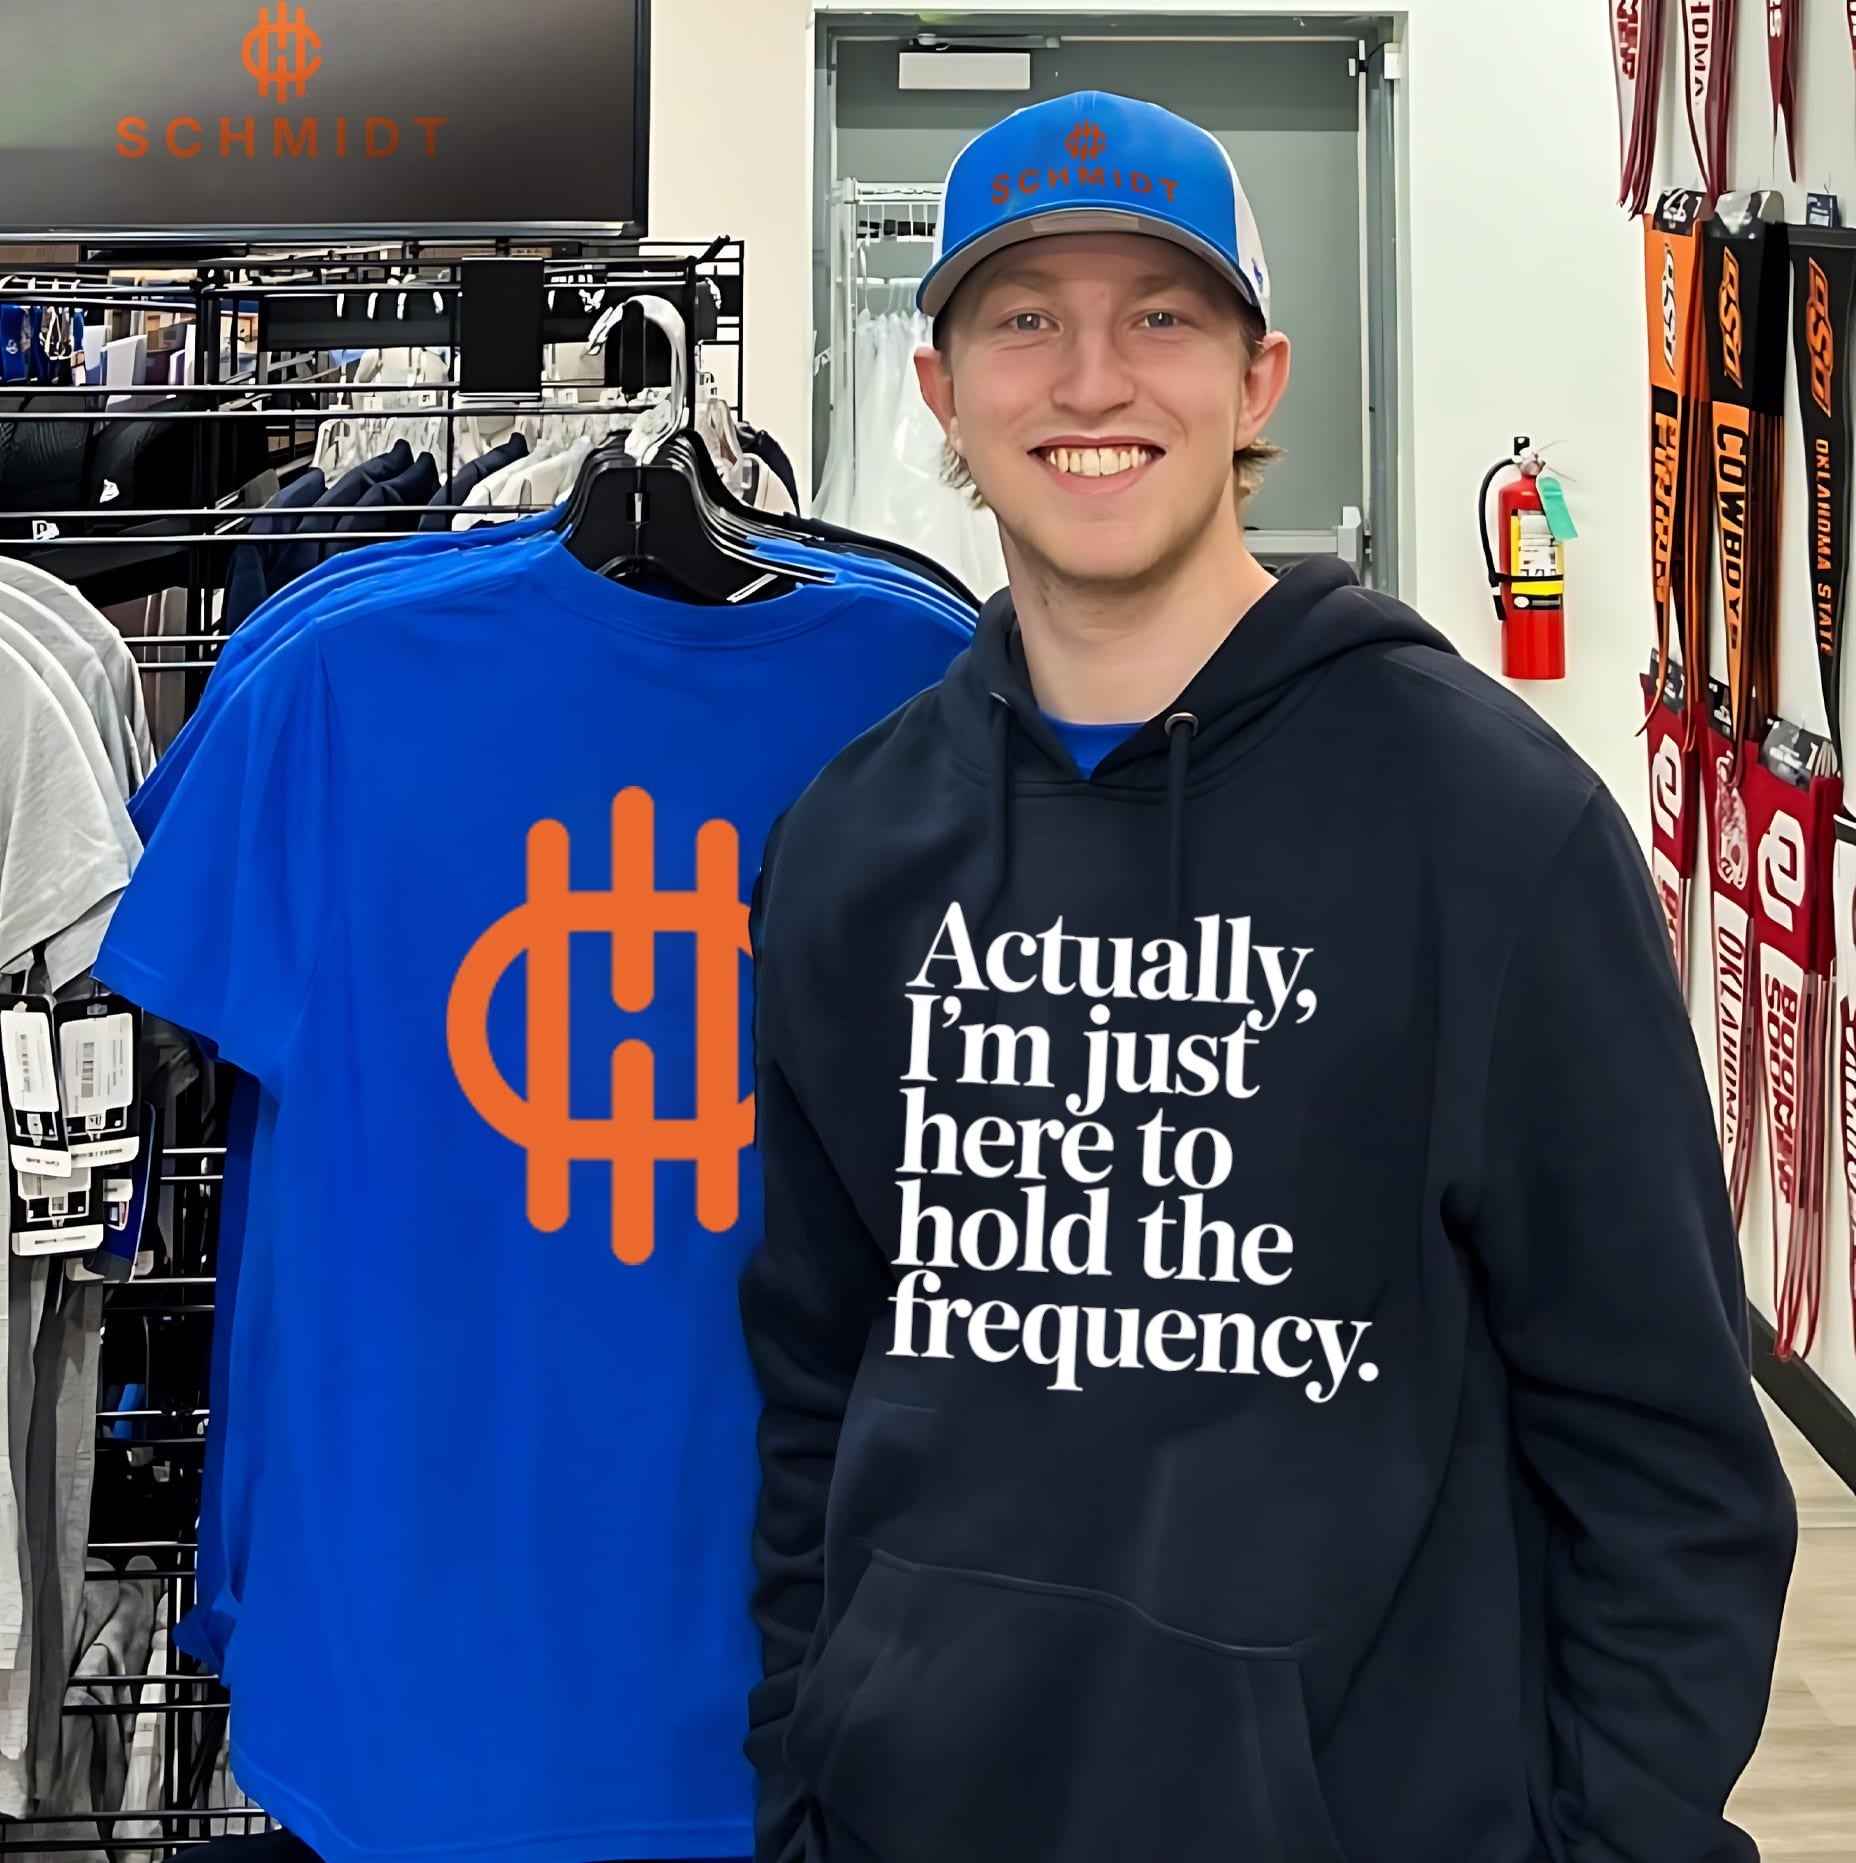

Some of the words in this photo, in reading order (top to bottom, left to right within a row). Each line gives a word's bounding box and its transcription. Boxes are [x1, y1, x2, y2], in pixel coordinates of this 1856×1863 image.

[116, 116, 447, 158] SCHMIDT
[991, 167, 1180, 205] SCHMIDT
[1814, 438, 1832, 570] OKLAHOMA
[906, 902, 1317, 1031] Actually,
[899, 994, 1055, 1087] I’m
[1066, 1003, 1260, 1116] just
[895, 1087, 1114, 1183] here
[1137, 1108, 1232, 1189] to
[890, 1179, 1112, 1275] hold
[1138, 1193, 1293, 1285] the
[886, 1270, 1378, 1403] frequency.
